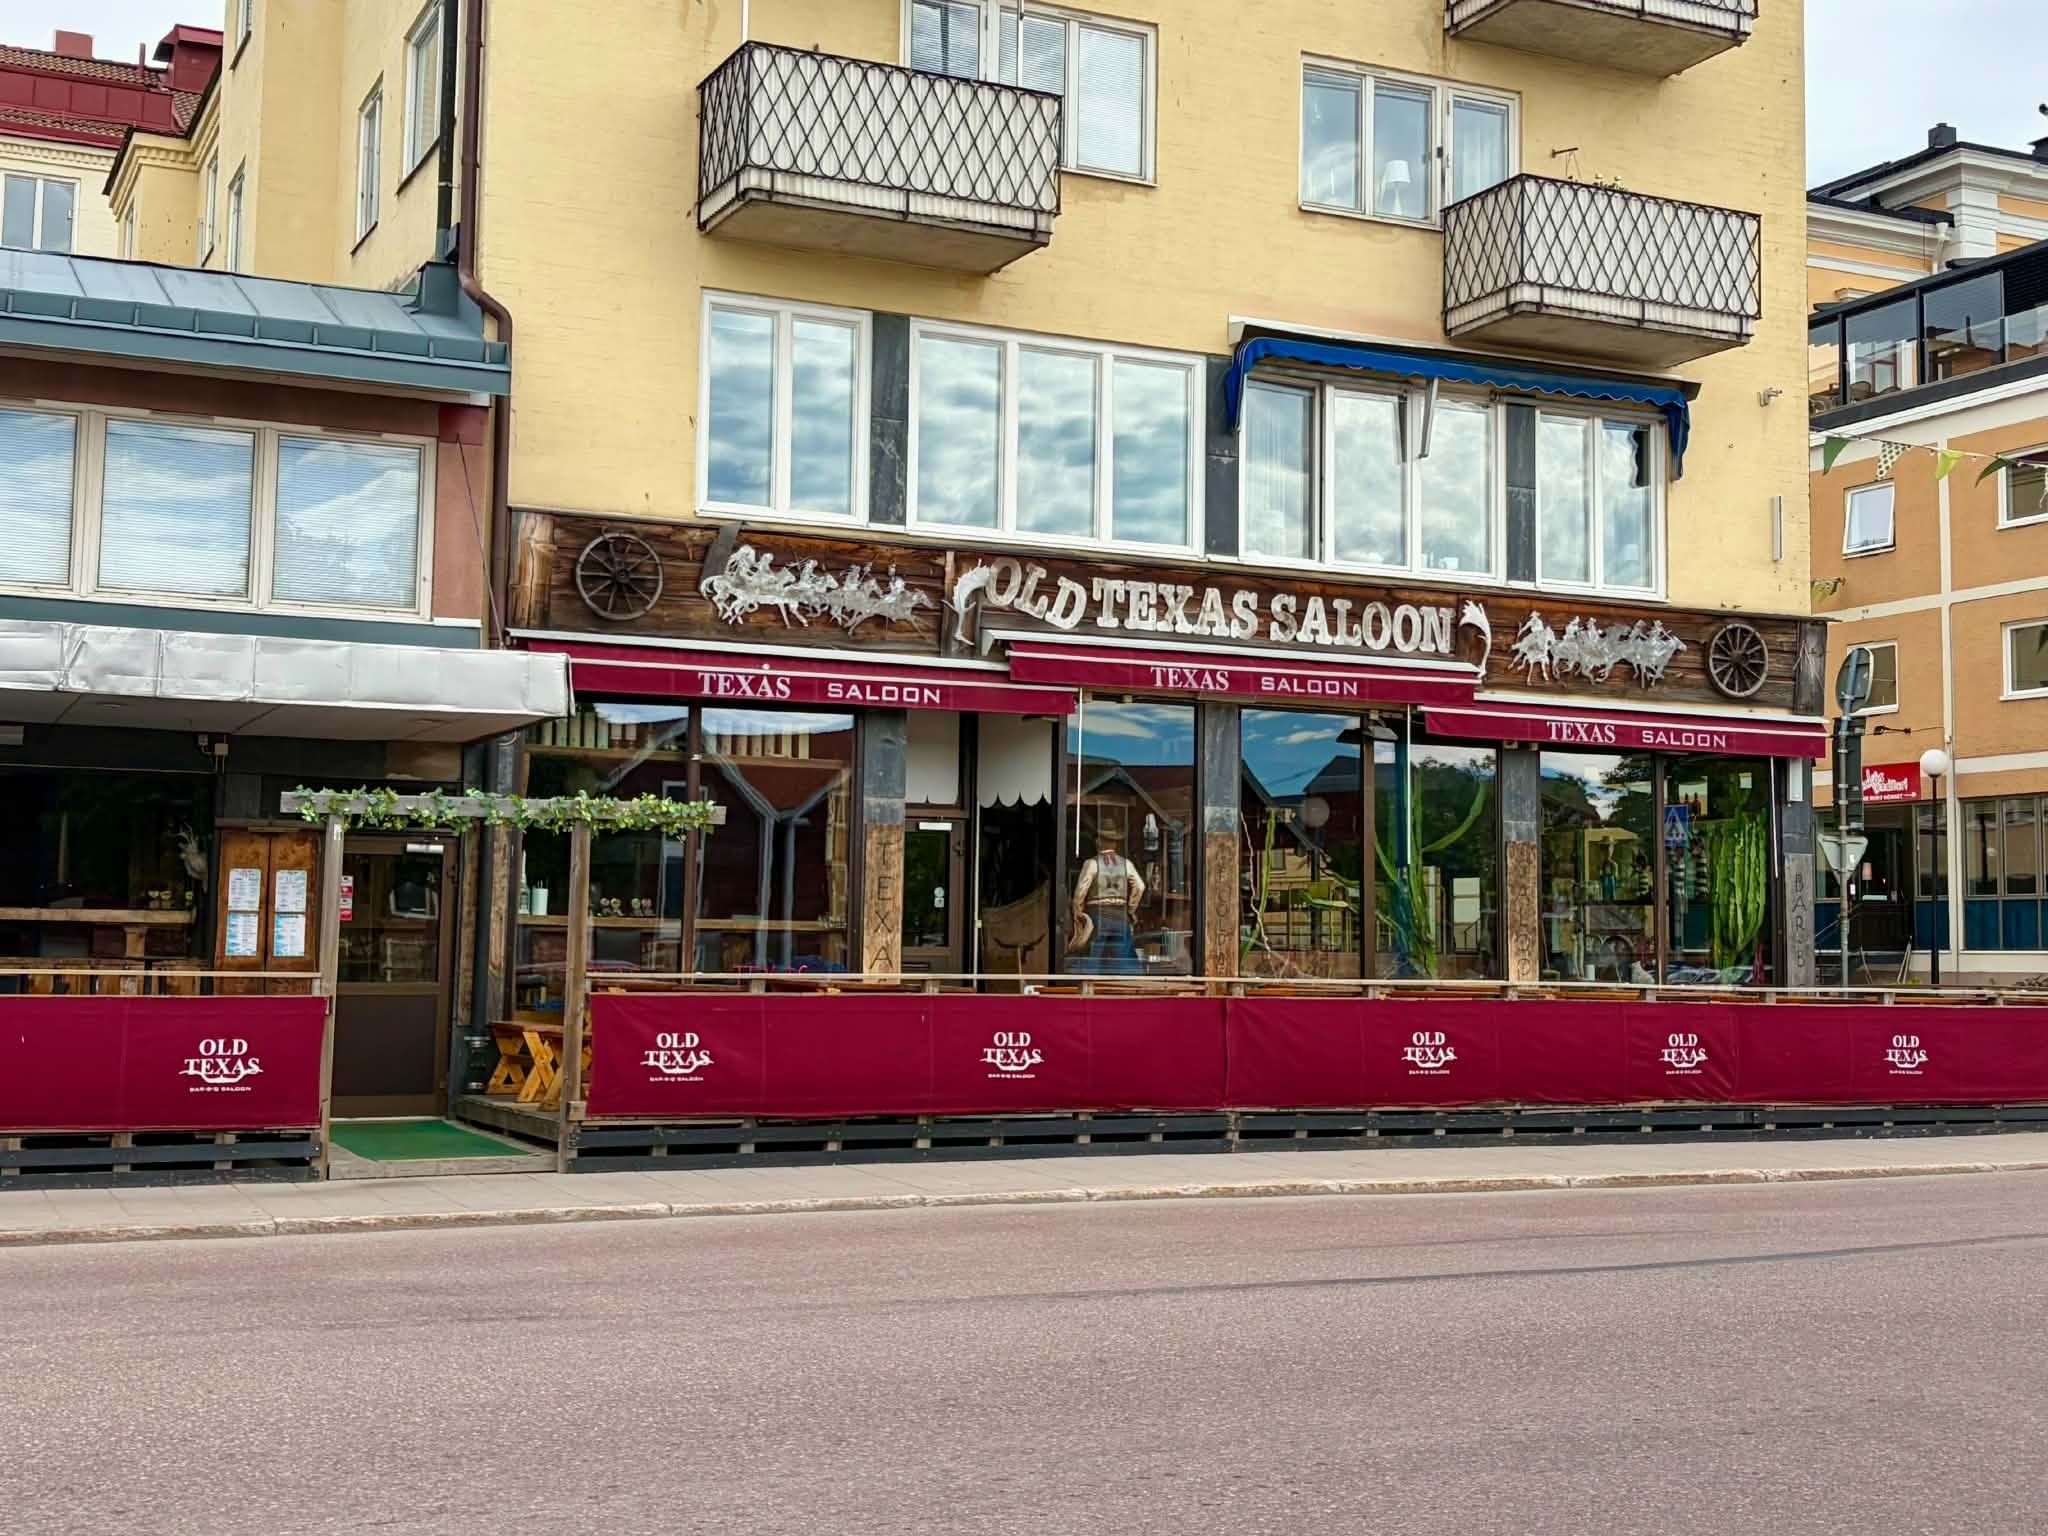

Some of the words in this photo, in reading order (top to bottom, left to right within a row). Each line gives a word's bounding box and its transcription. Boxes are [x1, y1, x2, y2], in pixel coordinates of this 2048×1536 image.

[984, 557, 1087, 630] OLD
[1091, 576, 1259, 641] TEXAS
[1269, 593, 1457, 654] SALOON
[698, 671, 792, 699] TEXAS
[827, 682, 941, 705] SALOON
[1150, 666, 1230, 692] TEXAS
[1261, 676, 1359, 696] SALOON
[1546, 720, 1617, 744] TEXAS
[1641, 729, 1727, 748] SALOON
[868, 841, 901, 985] TEXA
[656, 1032, 699, 1049] OLD
[993, 1031, 1031, 1047] OLD
[1412, 1031, 1446, 1046] OLD
[1668, 1033, 1698, 1047] OLD
[1892, 1034, 1920, 1048] OLD
[199, 1039, 248, 1056] OLD
[1403, 1047, 1455, 1061] TEXAS
[1661, 1048, 1706, 1061] TEXAS
[1886, 1049, 1927, 1062] TEXAS
[644, 1050, 711, 1066] TEXAS
[983, 1048, 1042, 1064] TEXAS
[184, 1057, 261, 1075] TEXAS
